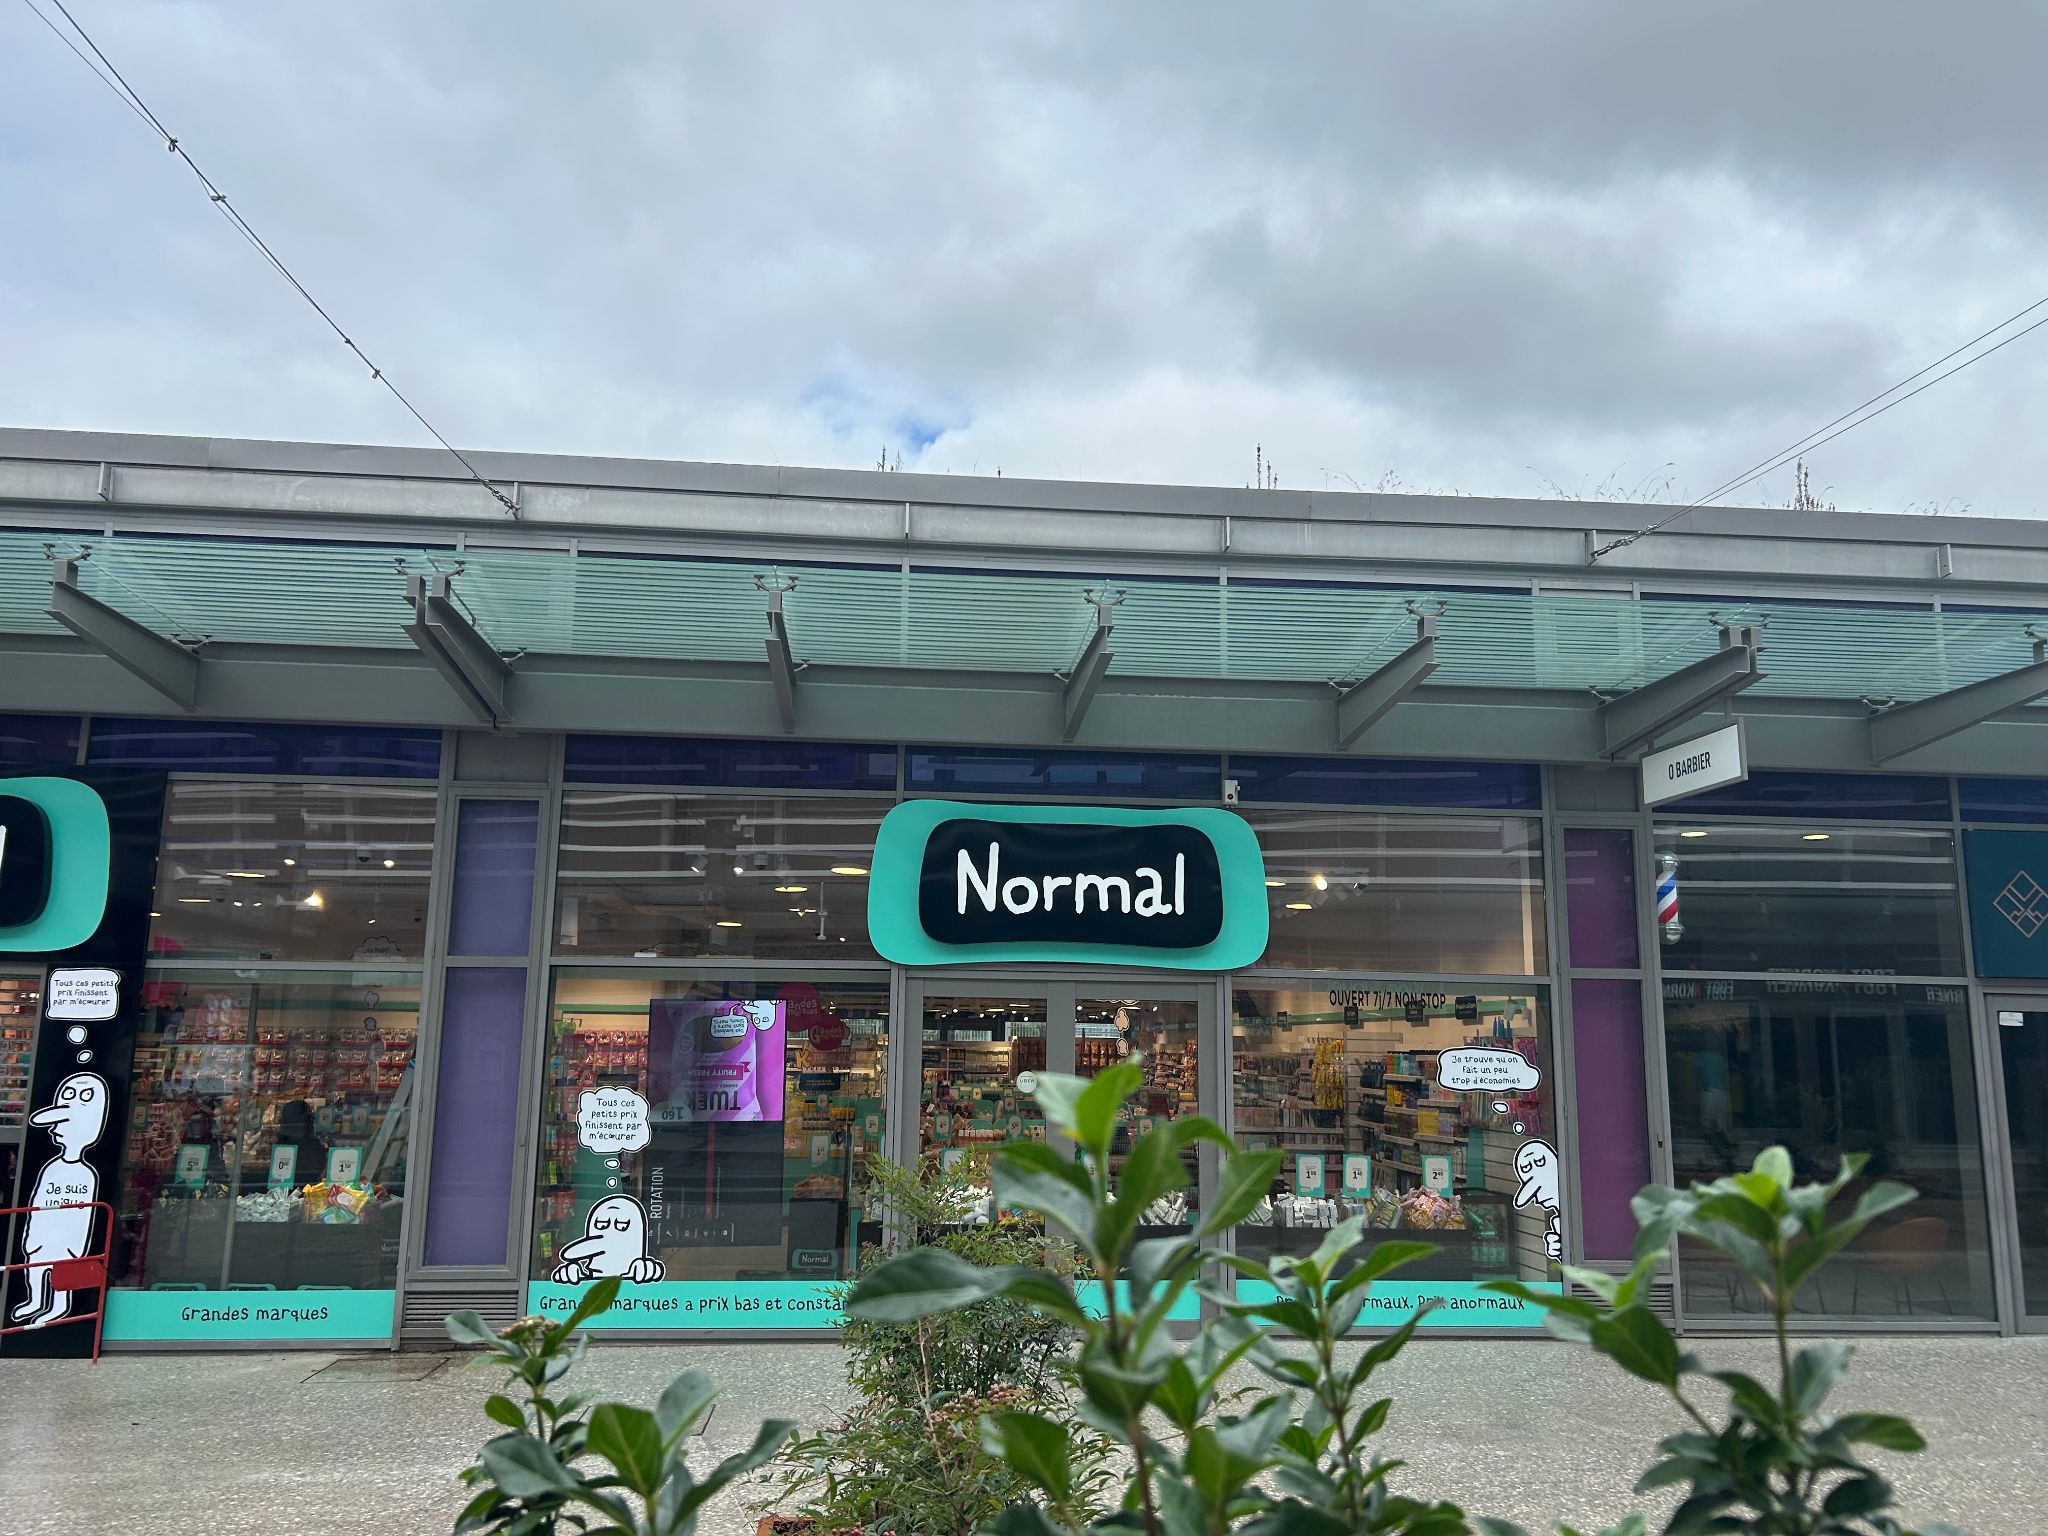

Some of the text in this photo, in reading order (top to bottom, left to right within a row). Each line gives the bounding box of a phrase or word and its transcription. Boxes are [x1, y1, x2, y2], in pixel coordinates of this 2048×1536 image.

[1668, 751, 1712, 780] O BARBIER
[957, 841, 1185, 917] Normal
[54, 979, 73, 987] Tous
[91, 980, 114, 988] petits
[57, 989, 73, 997] prix
[1329, 989, 1371, 1007] OUVERT
[1373, 990, 1393, 1010] 7j/7
[1395, 991, 1420, 1008] NON
[1420, 992, 1446, 1009] STOP
[1452, 1056, 1462, 1064] Je
[1464, 1055, 1494, 1063] trouve
[1493, 1067, 1509, 1075] peu
[1452, 1077, 1470, 1085] trop
[596, 1098, 618, 1107] Tous
[591, 1110, 638, 1119] petits prix
[585, 1120, 642, 1131] finissent par
[46, 1182, 88, 1195] Je suis
[650, 1167, 664, 1219] ROTATION
[381, 1243, 400, 1252] Norm
[801, 1253, 829, 1263] Normal
[610, 1297, 678, 1312] marques
[700, 1296, 729, 1313] prix
[734, 1295, 760, 1311] bas
[765, 1298, 783, 1311] et
[1450, 1297, 1525, 1310] anormaux
[181, 1306, 328, 1322] Grandes marques
